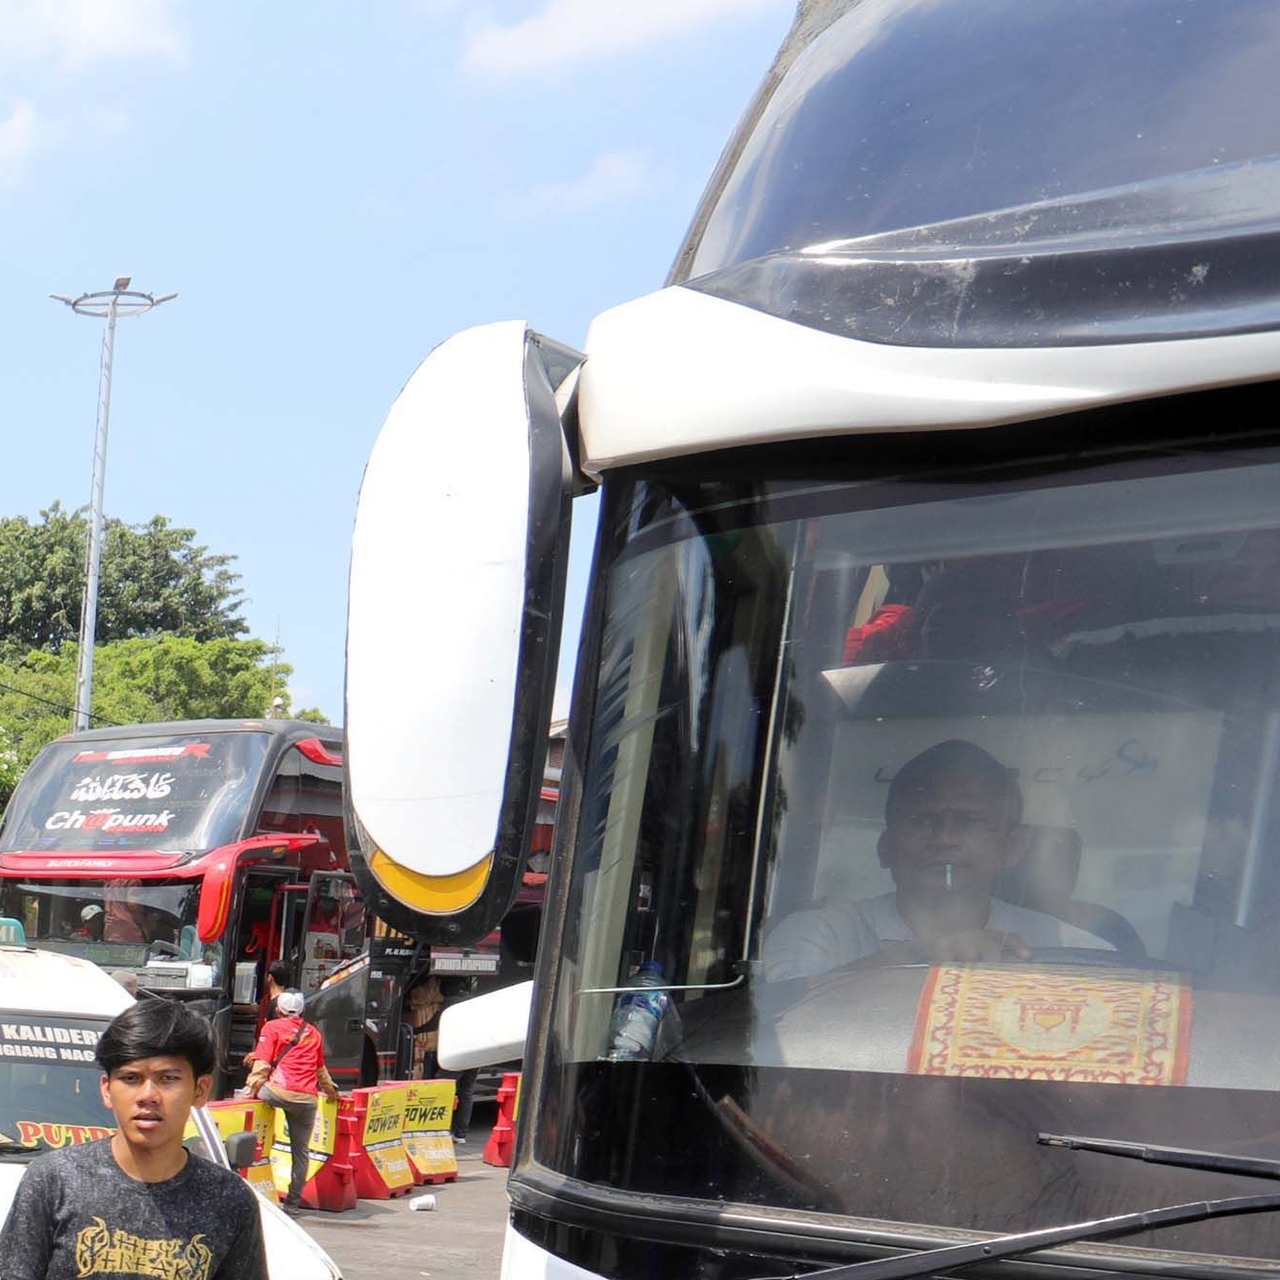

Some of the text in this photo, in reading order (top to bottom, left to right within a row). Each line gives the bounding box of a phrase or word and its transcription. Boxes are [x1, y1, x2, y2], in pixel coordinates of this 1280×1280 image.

[60, 1047, 97, 1062] NAG
[16, 1120, 120, 1148] PUTR
[366, 1114, 401, 1136] POWER
